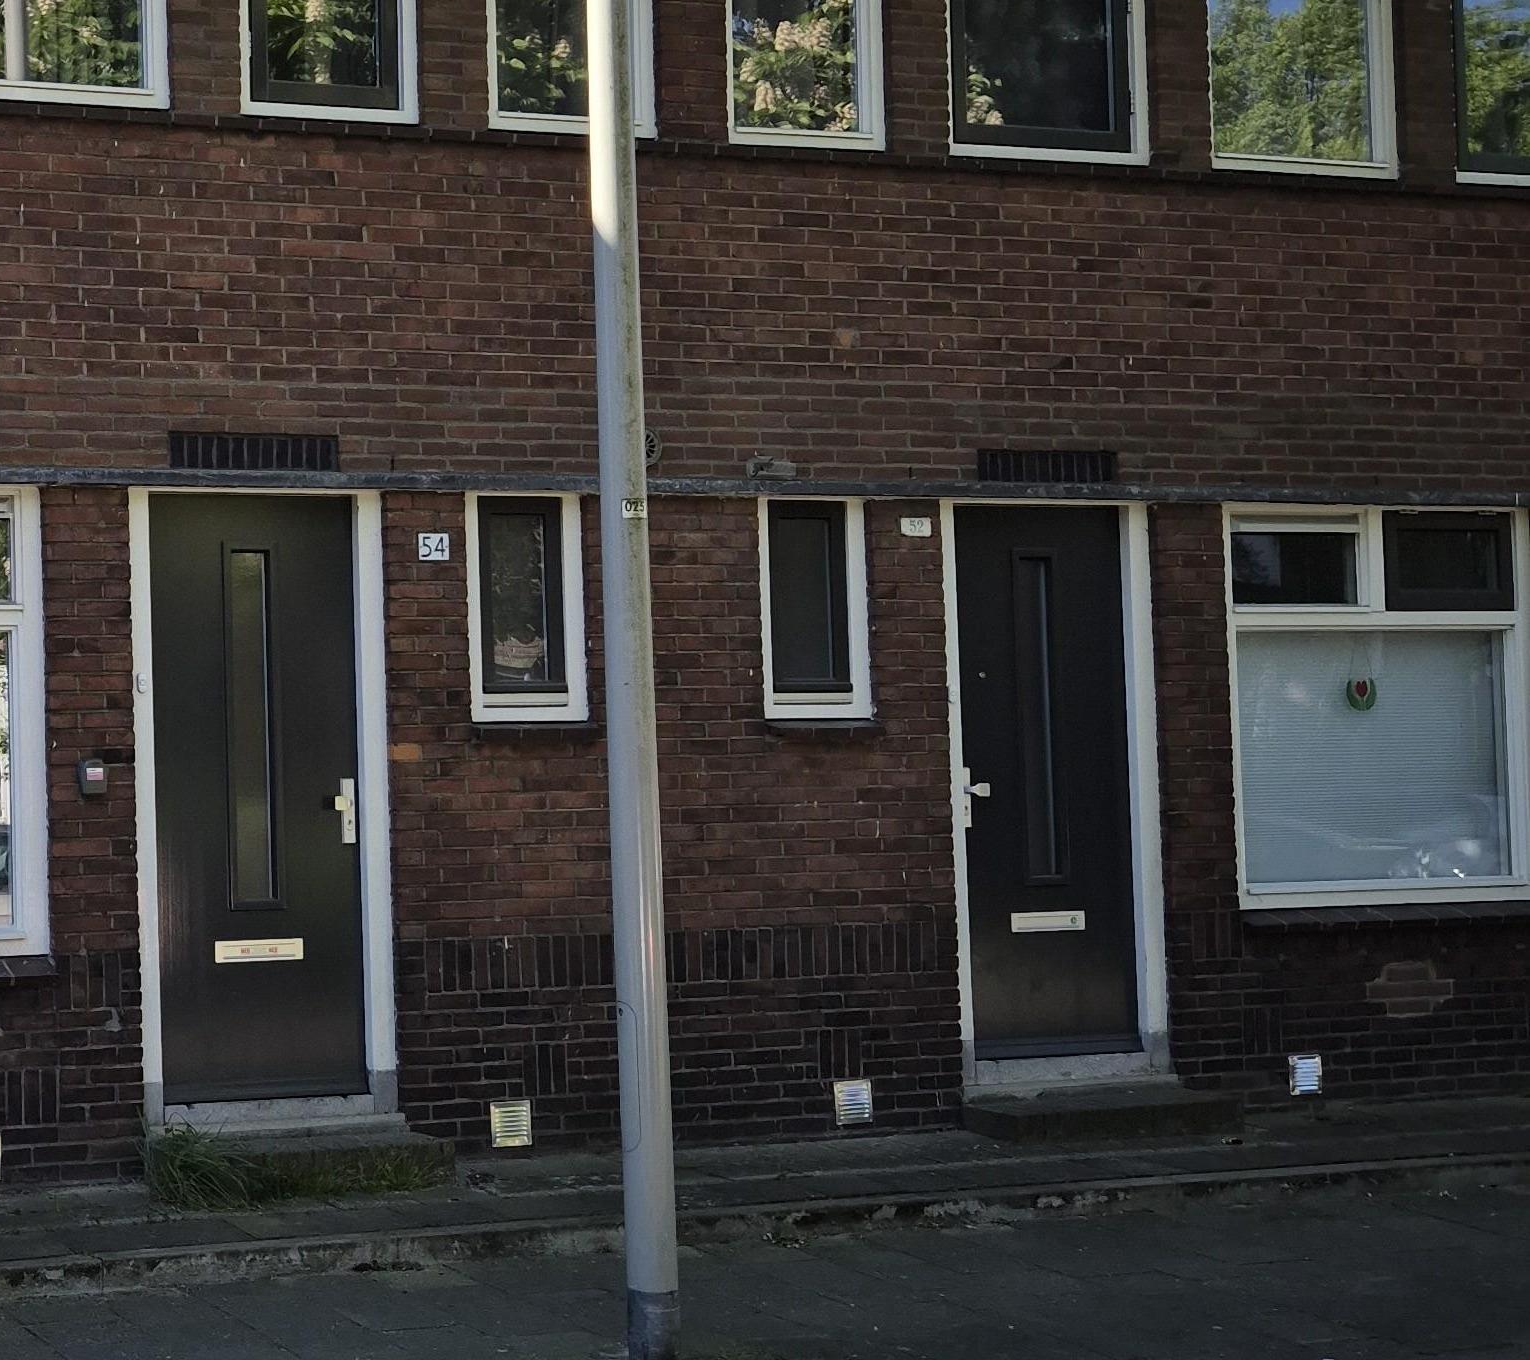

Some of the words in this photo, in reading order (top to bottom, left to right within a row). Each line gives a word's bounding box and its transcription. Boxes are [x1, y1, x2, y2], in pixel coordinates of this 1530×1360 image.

[625, 500, 645, 512] 025
[909, 519, 924, 533] 52
[421, 536, 446, 558] 54
